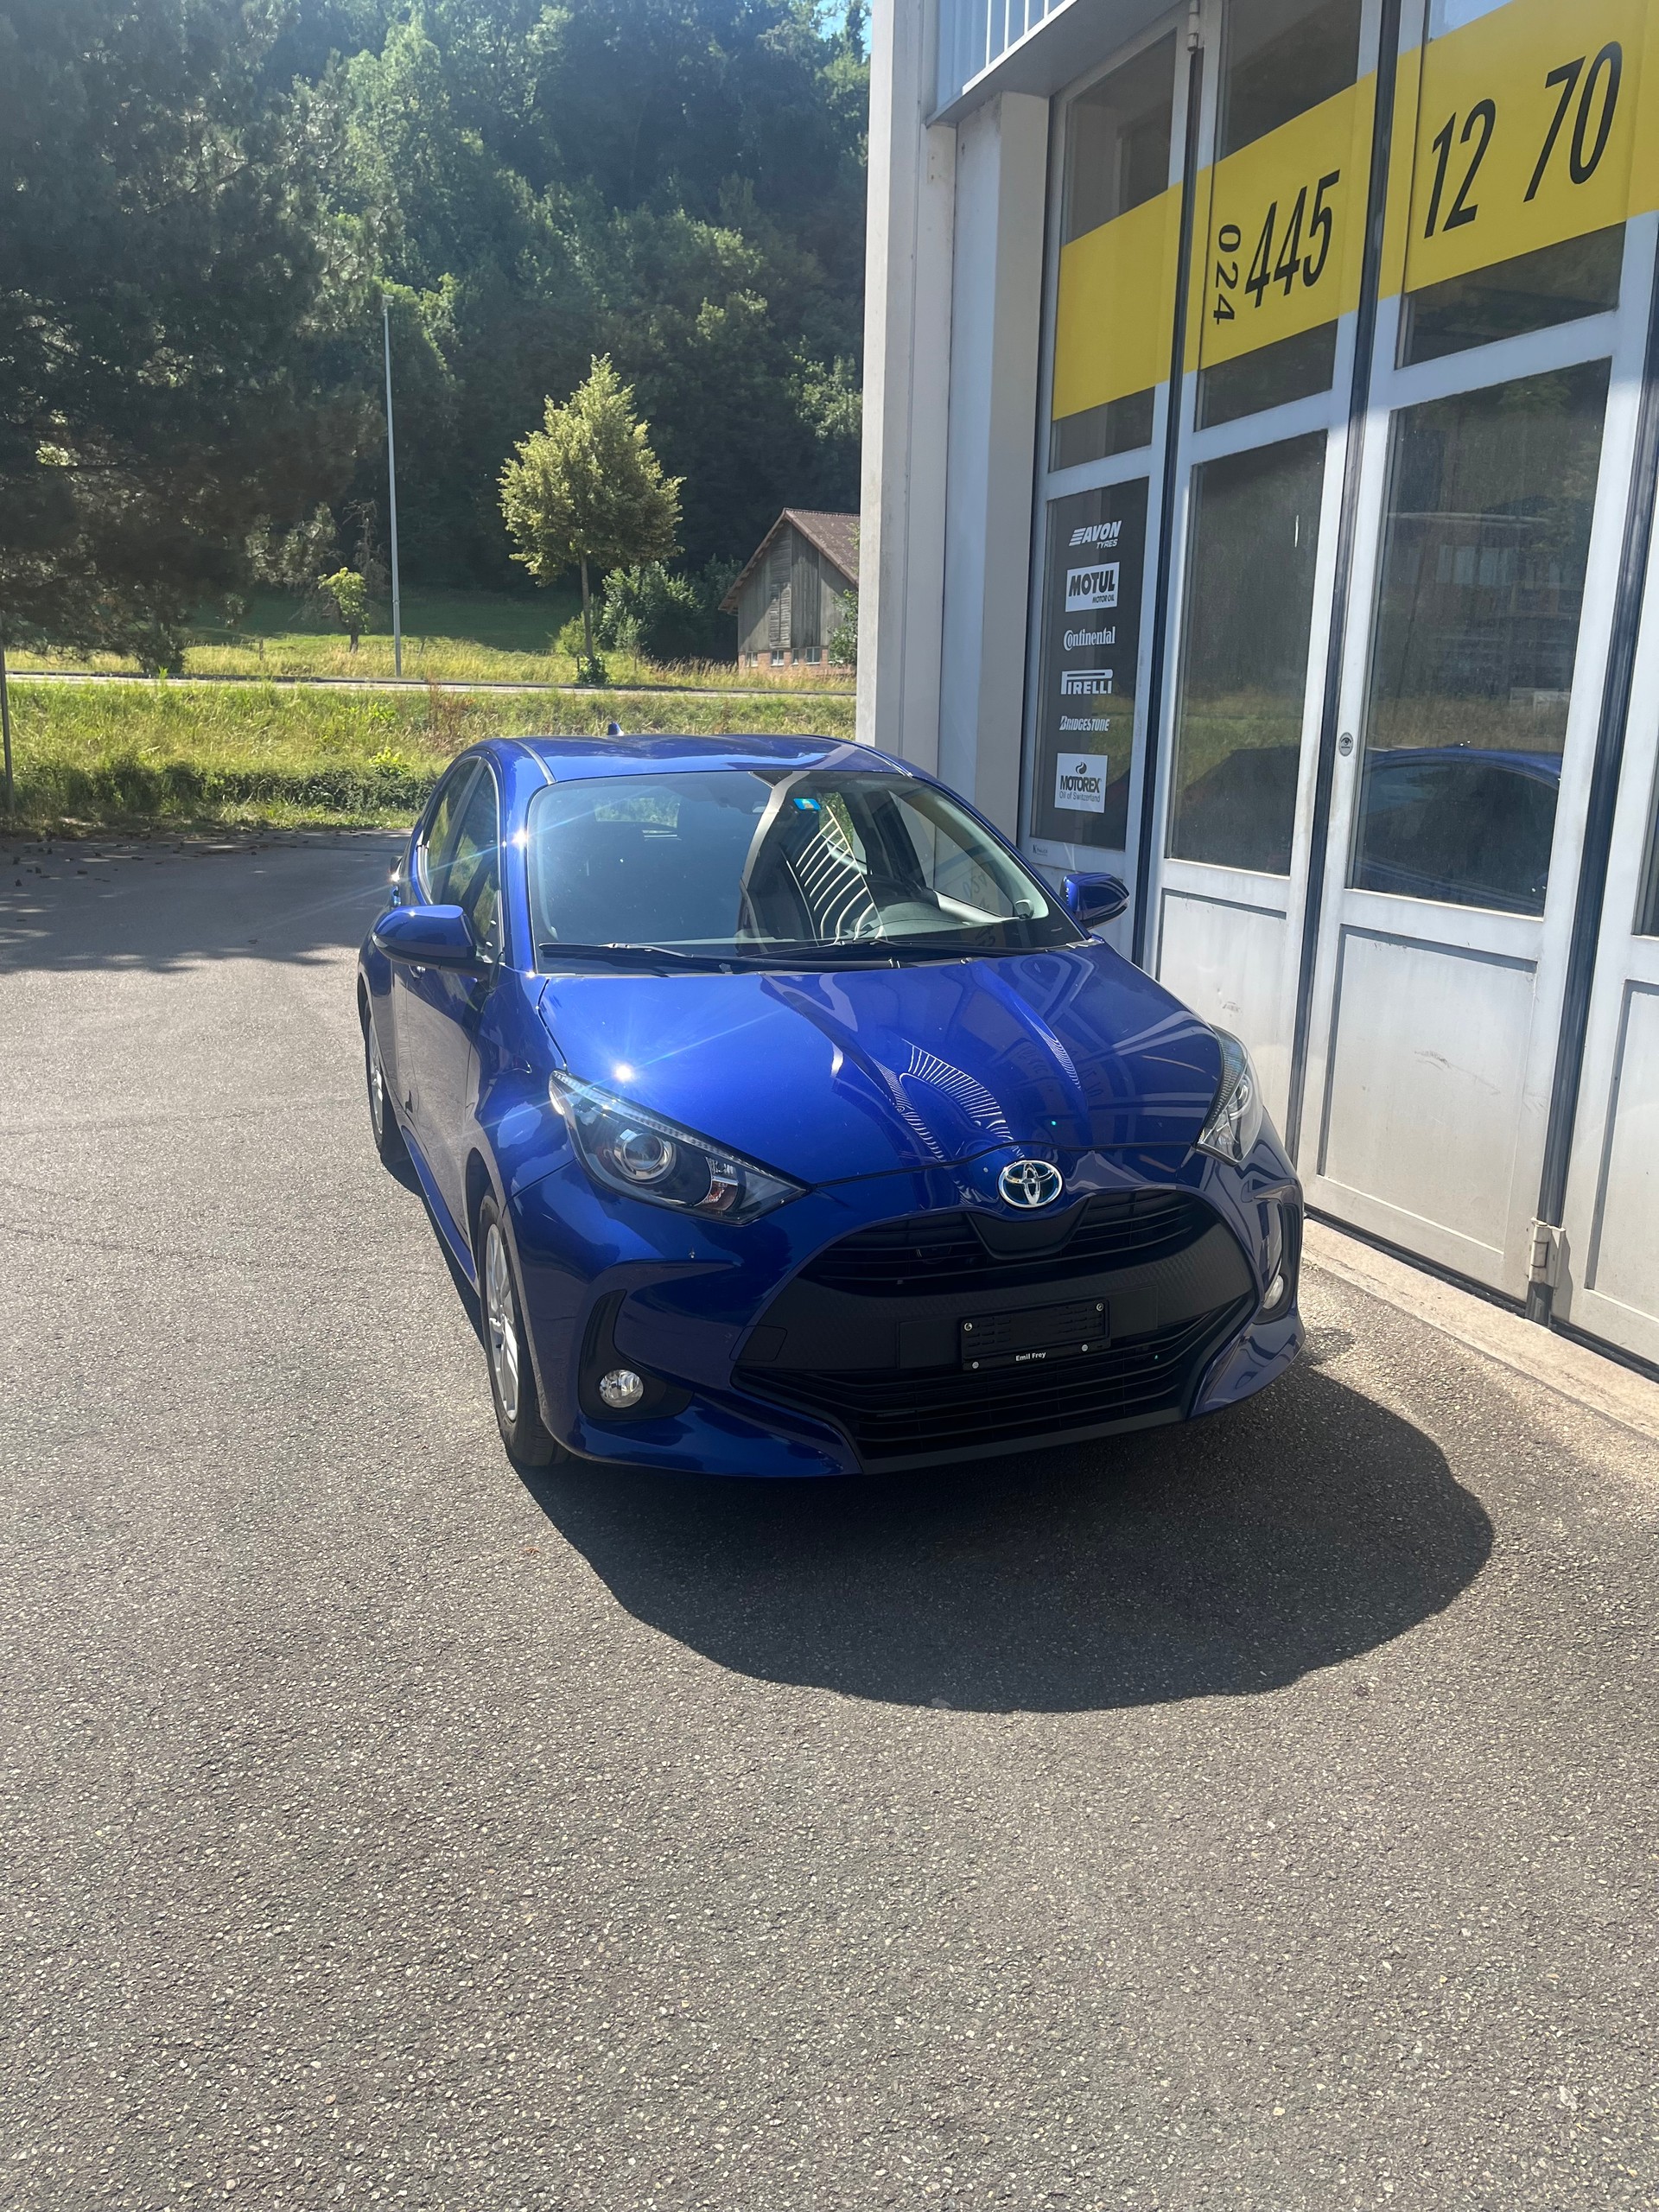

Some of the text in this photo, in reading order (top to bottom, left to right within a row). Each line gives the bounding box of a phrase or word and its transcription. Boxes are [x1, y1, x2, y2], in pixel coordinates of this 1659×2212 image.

[1213, 41, 1624, 325] 024 445 12 70
[1082, 520, 1122, 543] AVON
[1096, 535, 1118, 549] TYRES
[1069, 570, 1115, 596] MOTUL
[1064, 626, 1116, 651] Continental
[1060, 669, 1114, 695] PIRELLI
[1058, 715, 1110, 732] BRIDGESTONE
[1060, 775, 1100, 793] MOTOREX
[1073, 792, 1100, 802] Switzerland
